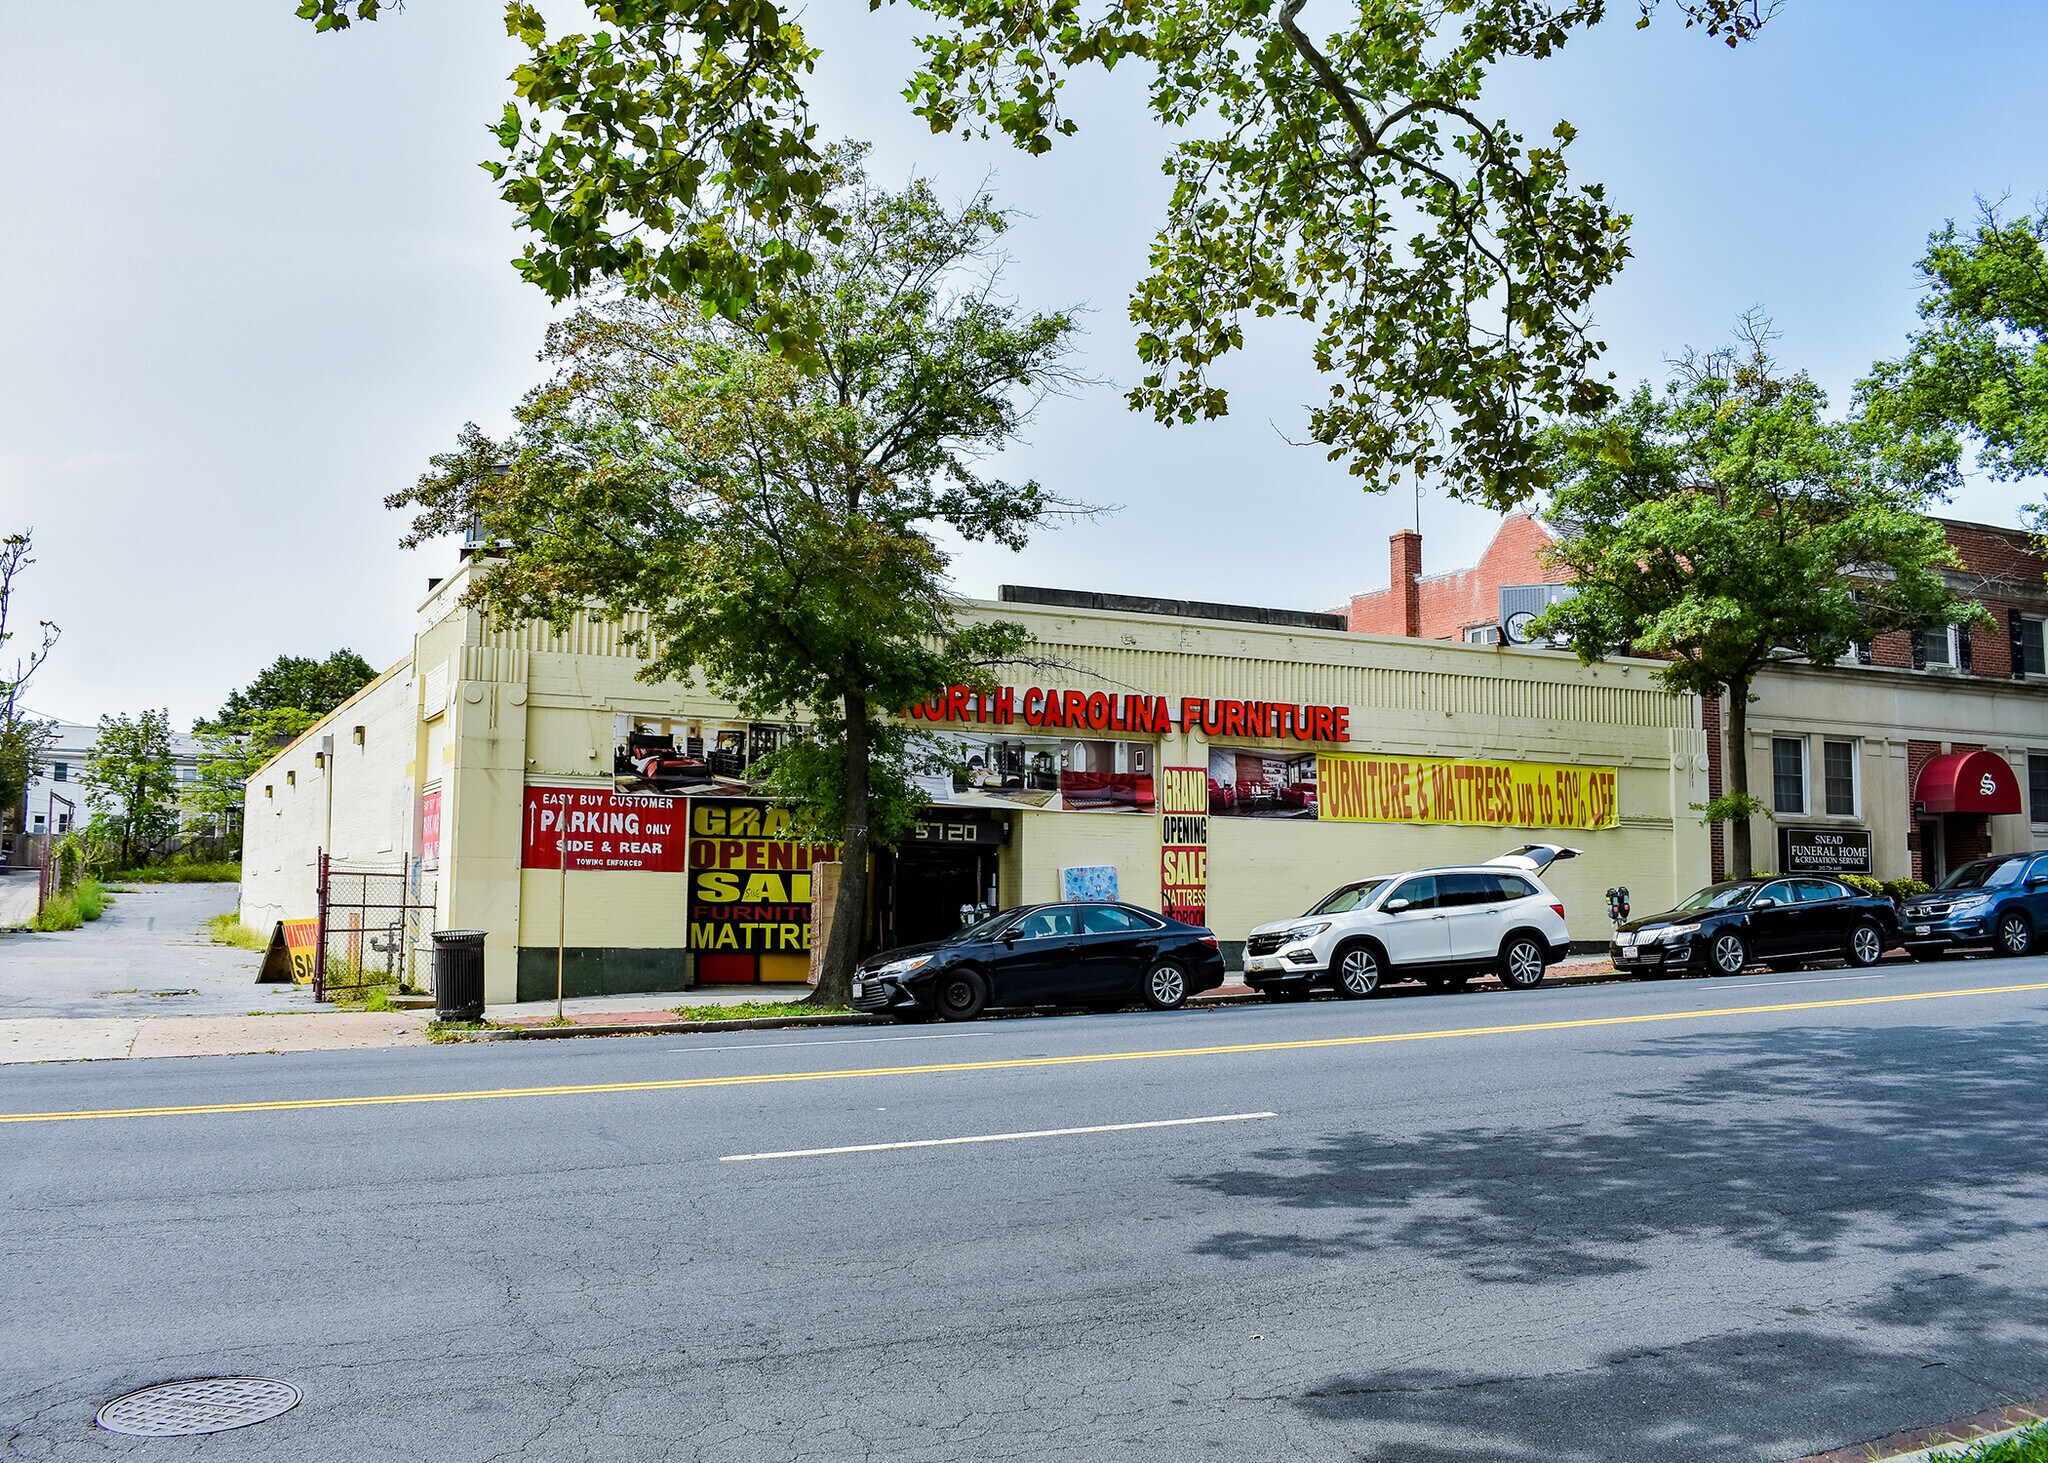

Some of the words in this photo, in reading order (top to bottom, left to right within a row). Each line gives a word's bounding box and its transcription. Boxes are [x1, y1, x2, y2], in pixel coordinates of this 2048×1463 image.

[1023, 687, 1172, 733] CAROLINA
[1181, 697, 1350, 742] FURNITURE
[1163, 769, 1206, 812] GRAND
[1318, 759, 1412, 819] FURNITURE
[1417, 763, 1428, 820] &
[1432, 764, 1512, 823] MATTRESS
[1517, 782, 1533, 827] up
[1537, 771, 1553, 824] to
[1556, 770, 1586, 828] 50%
[1590, 772, 1615, 826] OFF
[1980, 773, 1996, 795] S
[543, 793, 574, 805] EASY
[579, 795, 603, 806] BUY
[609, 796, 673, 808] CUSTOMER
[540, 809, 639, 835] PARKING
[645, 823, 671, 835] ONLY
[694, 806, 842, 837] GRA
[915, 822, 977, 841] 5720
[1163, 816, 1207, 844] OPENING
[556, 840, 593, 852] SIDE
[601, 841, 612, 853] &
[620, 842, 662, 854] REAR
[1791, 845, 1836, 856] FUNERAL
[1839, 847, 1868, 857] HOME
[1815, 835, 1843, 844] SNEAD
[576, 858, 603, 866] TOWING
[606, 859, 643, 867] ENFORCED
[690, 840, 844, 870] OPENIN
[1839, 857, 1865, 865] SERVICE
[1163, 850, 1206, 886] SALE
[697, 872, 812, 903] SAL
[694, 906, 811, 921] FURNIT
[690, 923, 812, 949] MATTRE
[294, 953, 315, 978] SA
